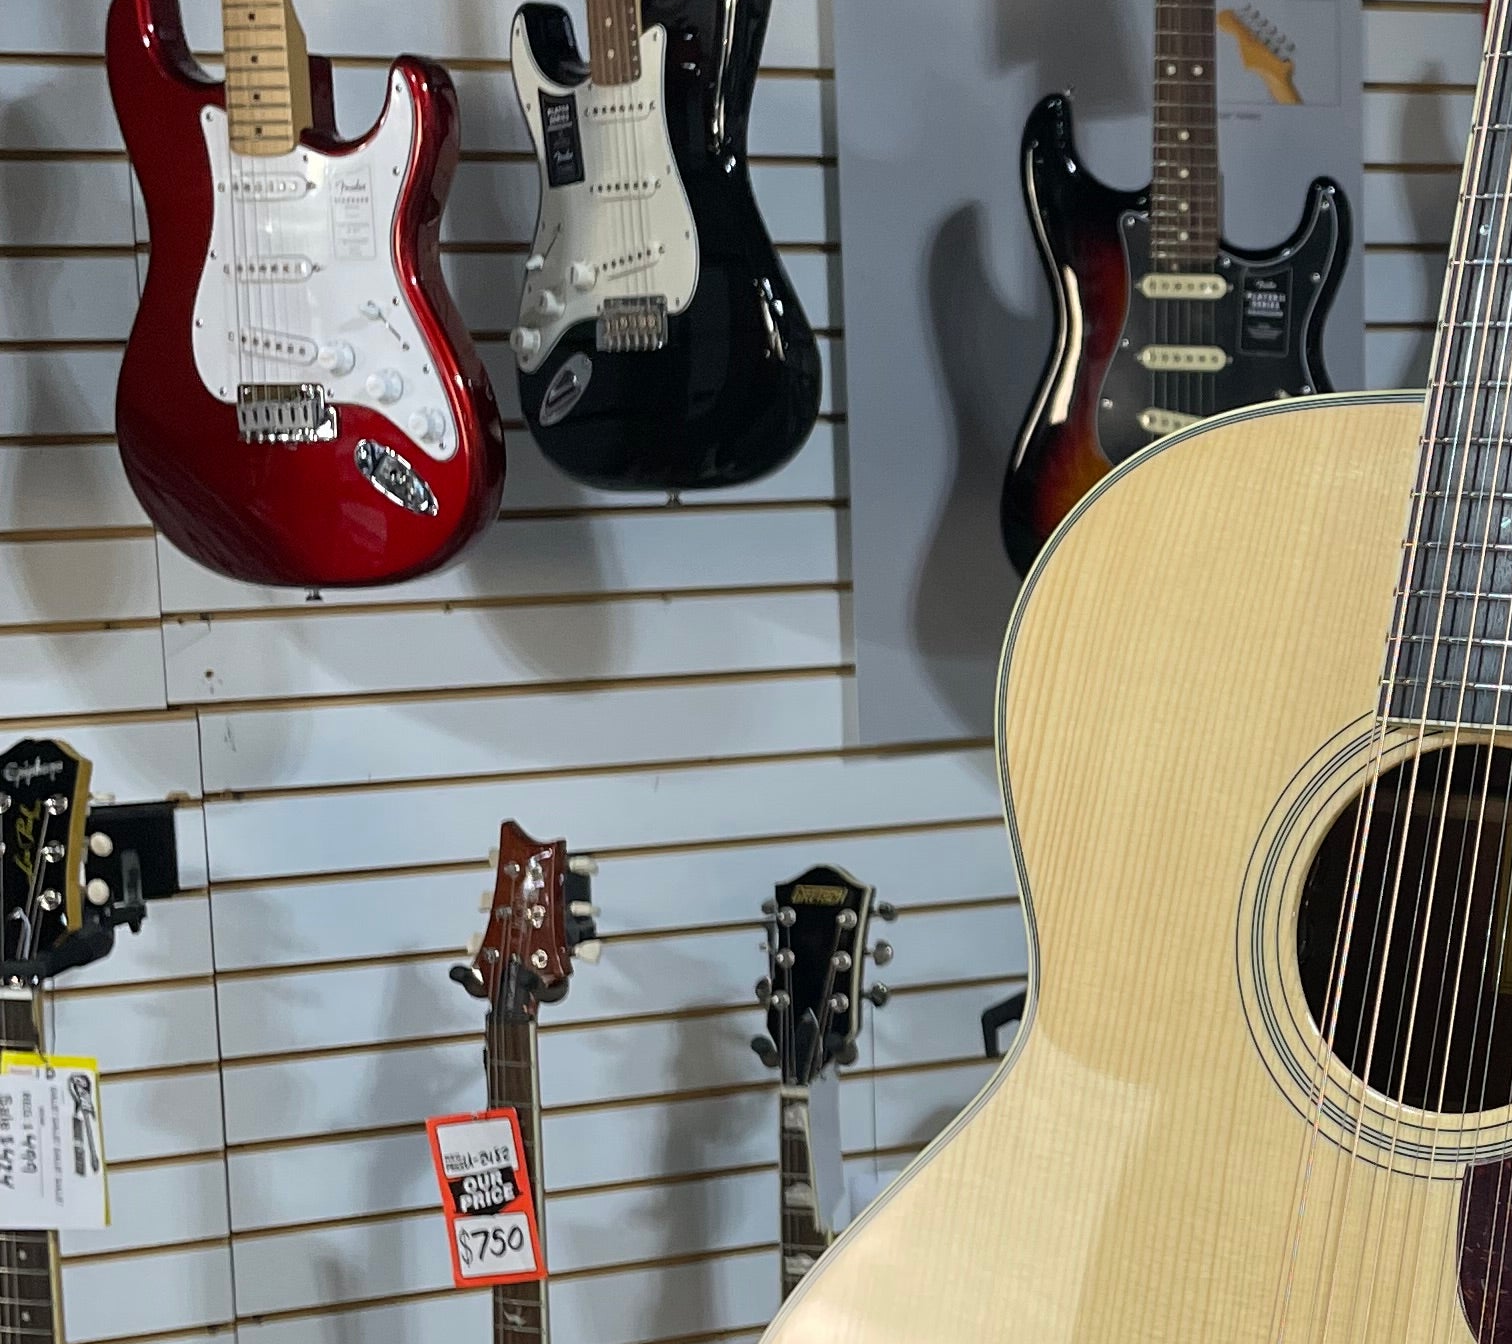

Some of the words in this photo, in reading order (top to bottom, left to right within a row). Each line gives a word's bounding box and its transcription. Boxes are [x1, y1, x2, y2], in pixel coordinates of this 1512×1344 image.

[460, 1182, 515, 1214] PRICE
[463, 1170, 503, 1194] OUR
[458, 1224, 525, 1269] $750
